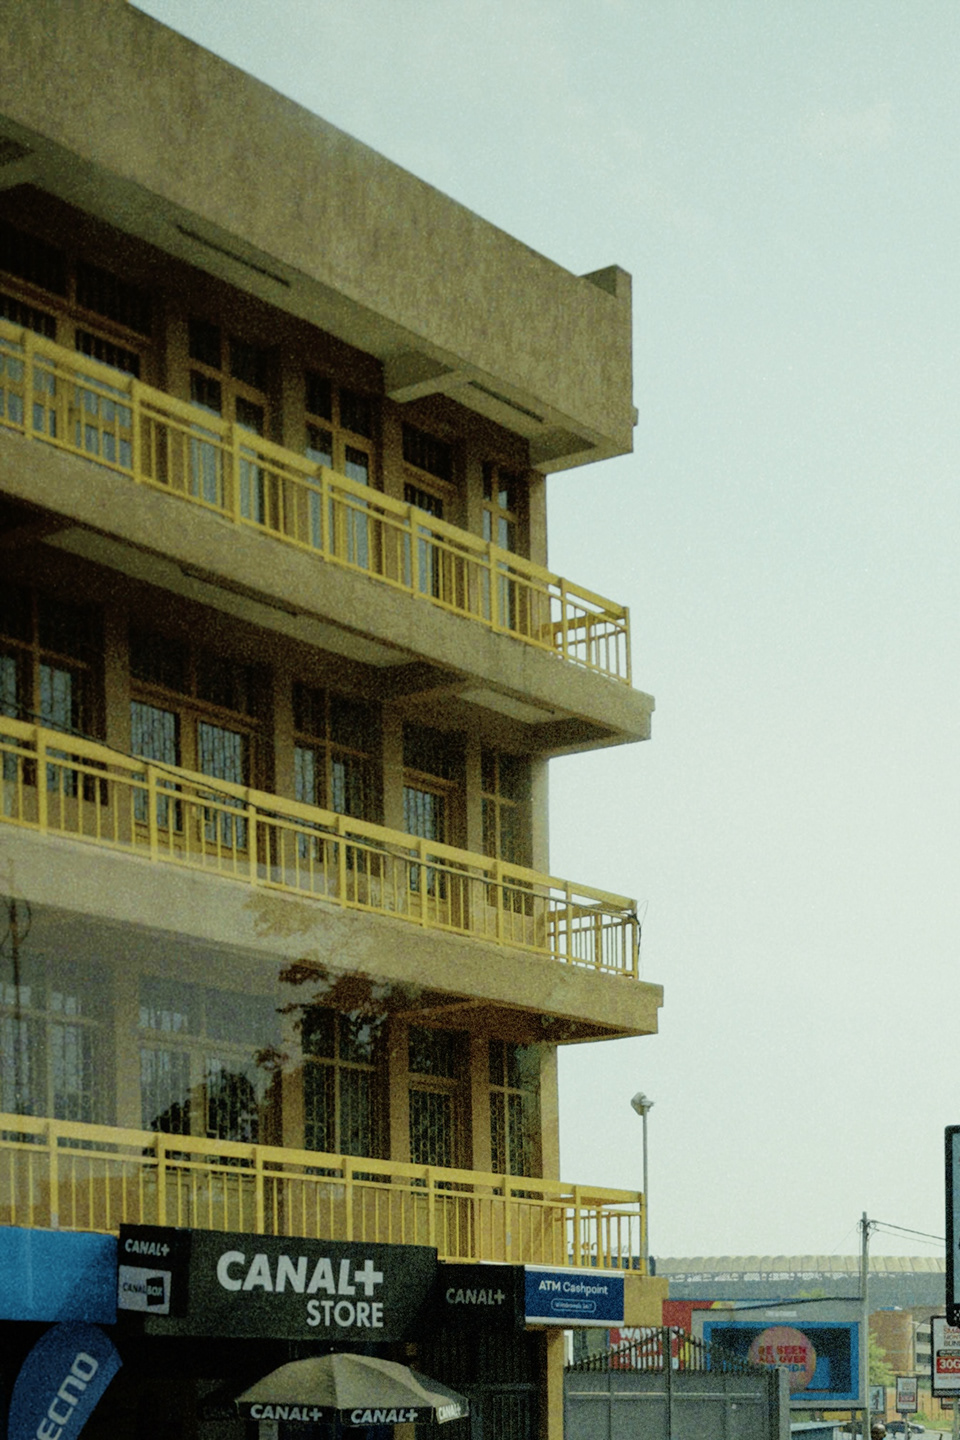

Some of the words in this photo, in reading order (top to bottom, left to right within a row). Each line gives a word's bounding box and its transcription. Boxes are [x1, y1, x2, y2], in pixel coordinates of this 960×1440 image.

[125, 1239, 170, 1257] CANAL+
[217, 1251, 384, 1297] CANAL+
[446, 1288, 506, 1306] CANAL+
[539, 1280, 561, 1292] ATM
[562, 1281, 608, 1297] Cashpoint
[306, 1300, 384, 1328] STORE
[758, 1346, 773, 1354] BE
[777, 1345, 806, 1354] SEEN
[759, 1355, 776, 1363] ALL
[779, 1355, 806, 1363] OVER
[250, 1404, 323, 1422] CANAL+
[350, 1408, 419, 1424] CANAL+
